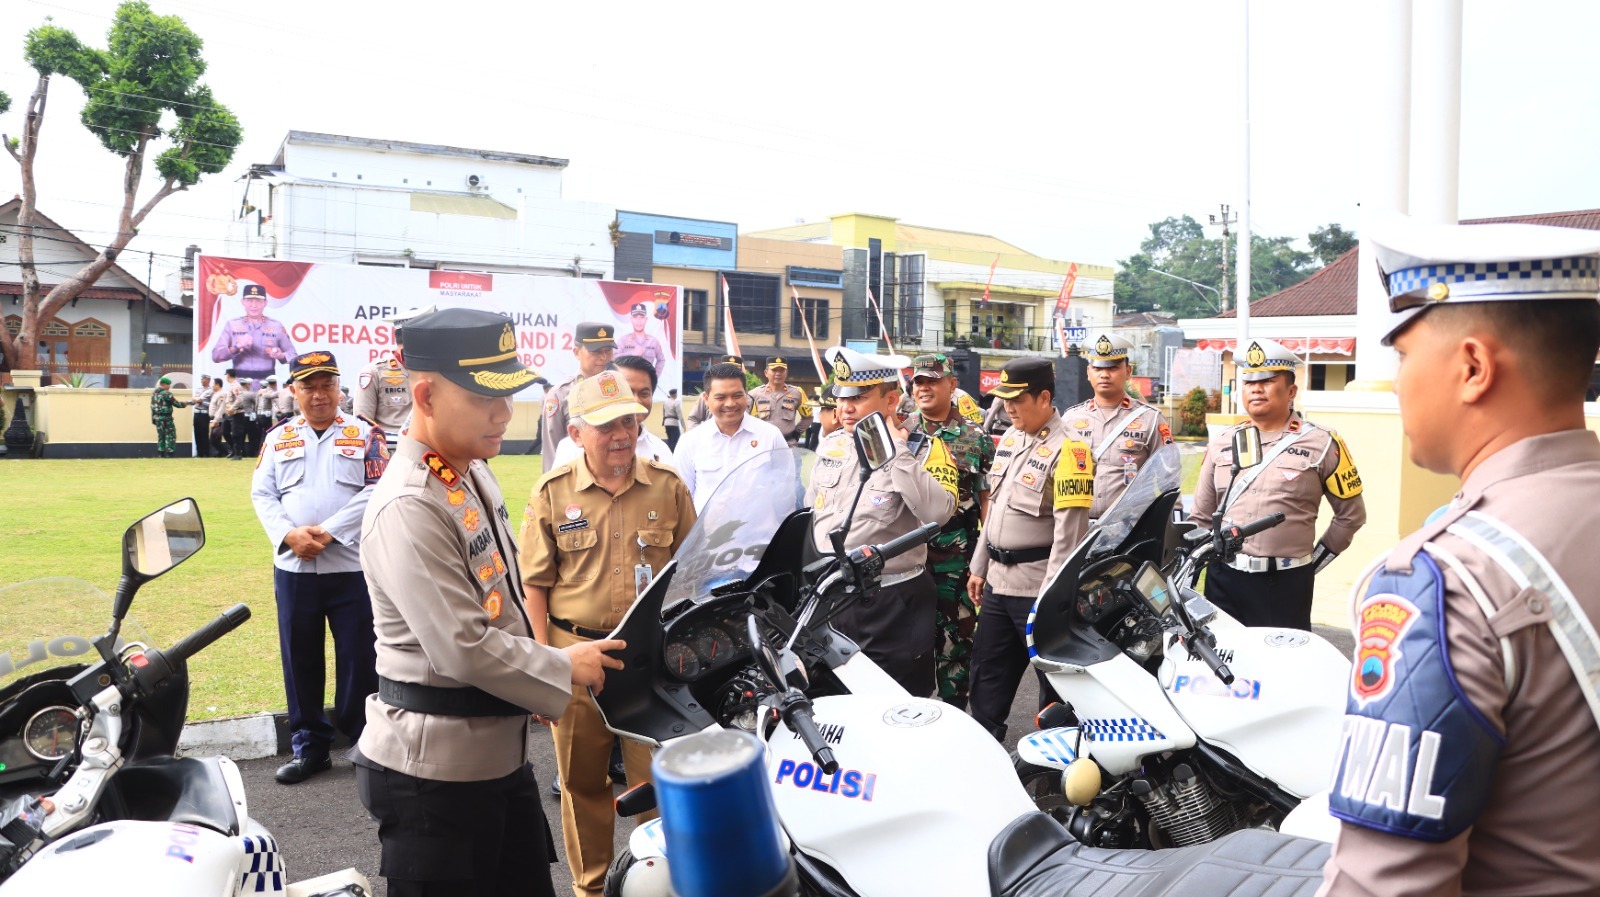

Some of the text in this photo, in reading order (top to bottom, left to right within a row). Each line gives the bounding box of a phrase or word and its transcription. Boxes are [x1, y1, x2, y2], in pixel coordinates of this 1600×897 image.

[499, 311, 558, 327] UKAN
[291, 323, 397, 345] OPERASI
[515, 331, 555, 350] NDI
[1027, 458, 1048, 471] POLRI
[469, 527, 493, 560] AKBAR
[774, 758, 878, 802] POLISI
